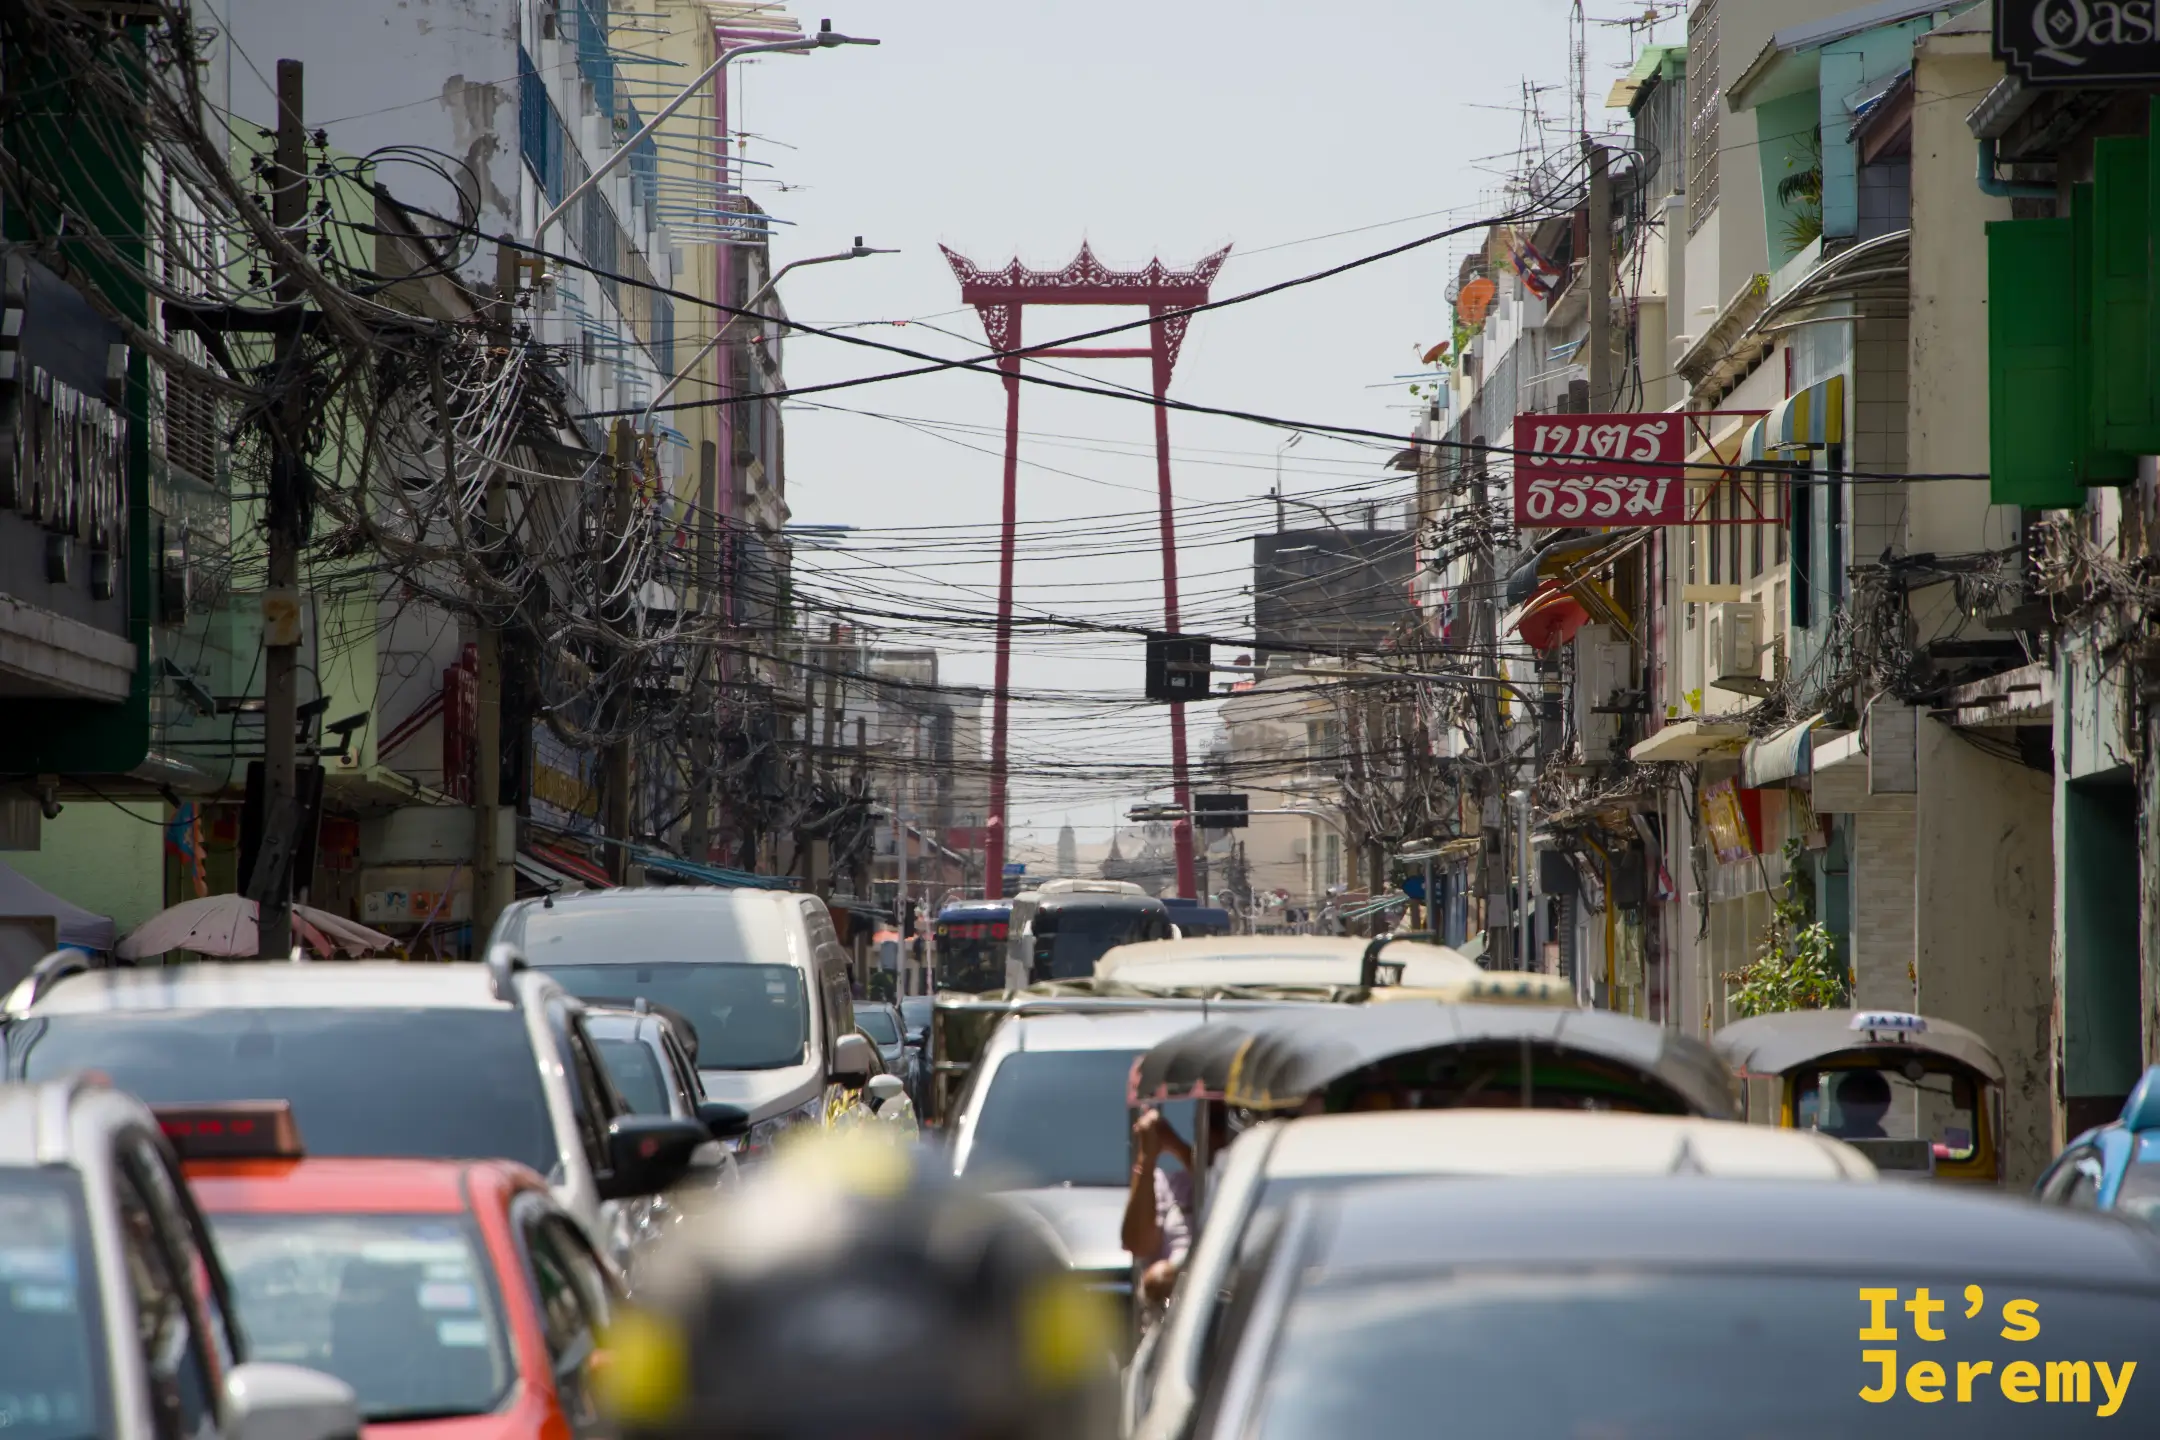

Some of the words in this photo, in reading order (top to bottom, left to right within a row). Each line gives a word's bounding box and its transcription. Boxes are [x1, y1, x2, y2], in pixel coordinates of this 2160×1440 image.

[2032, 0, 2160, 66] Qas
[1526, 476, 1671, 520] ธรรม
[1868, 1015, 1913, 1028] TAXI
